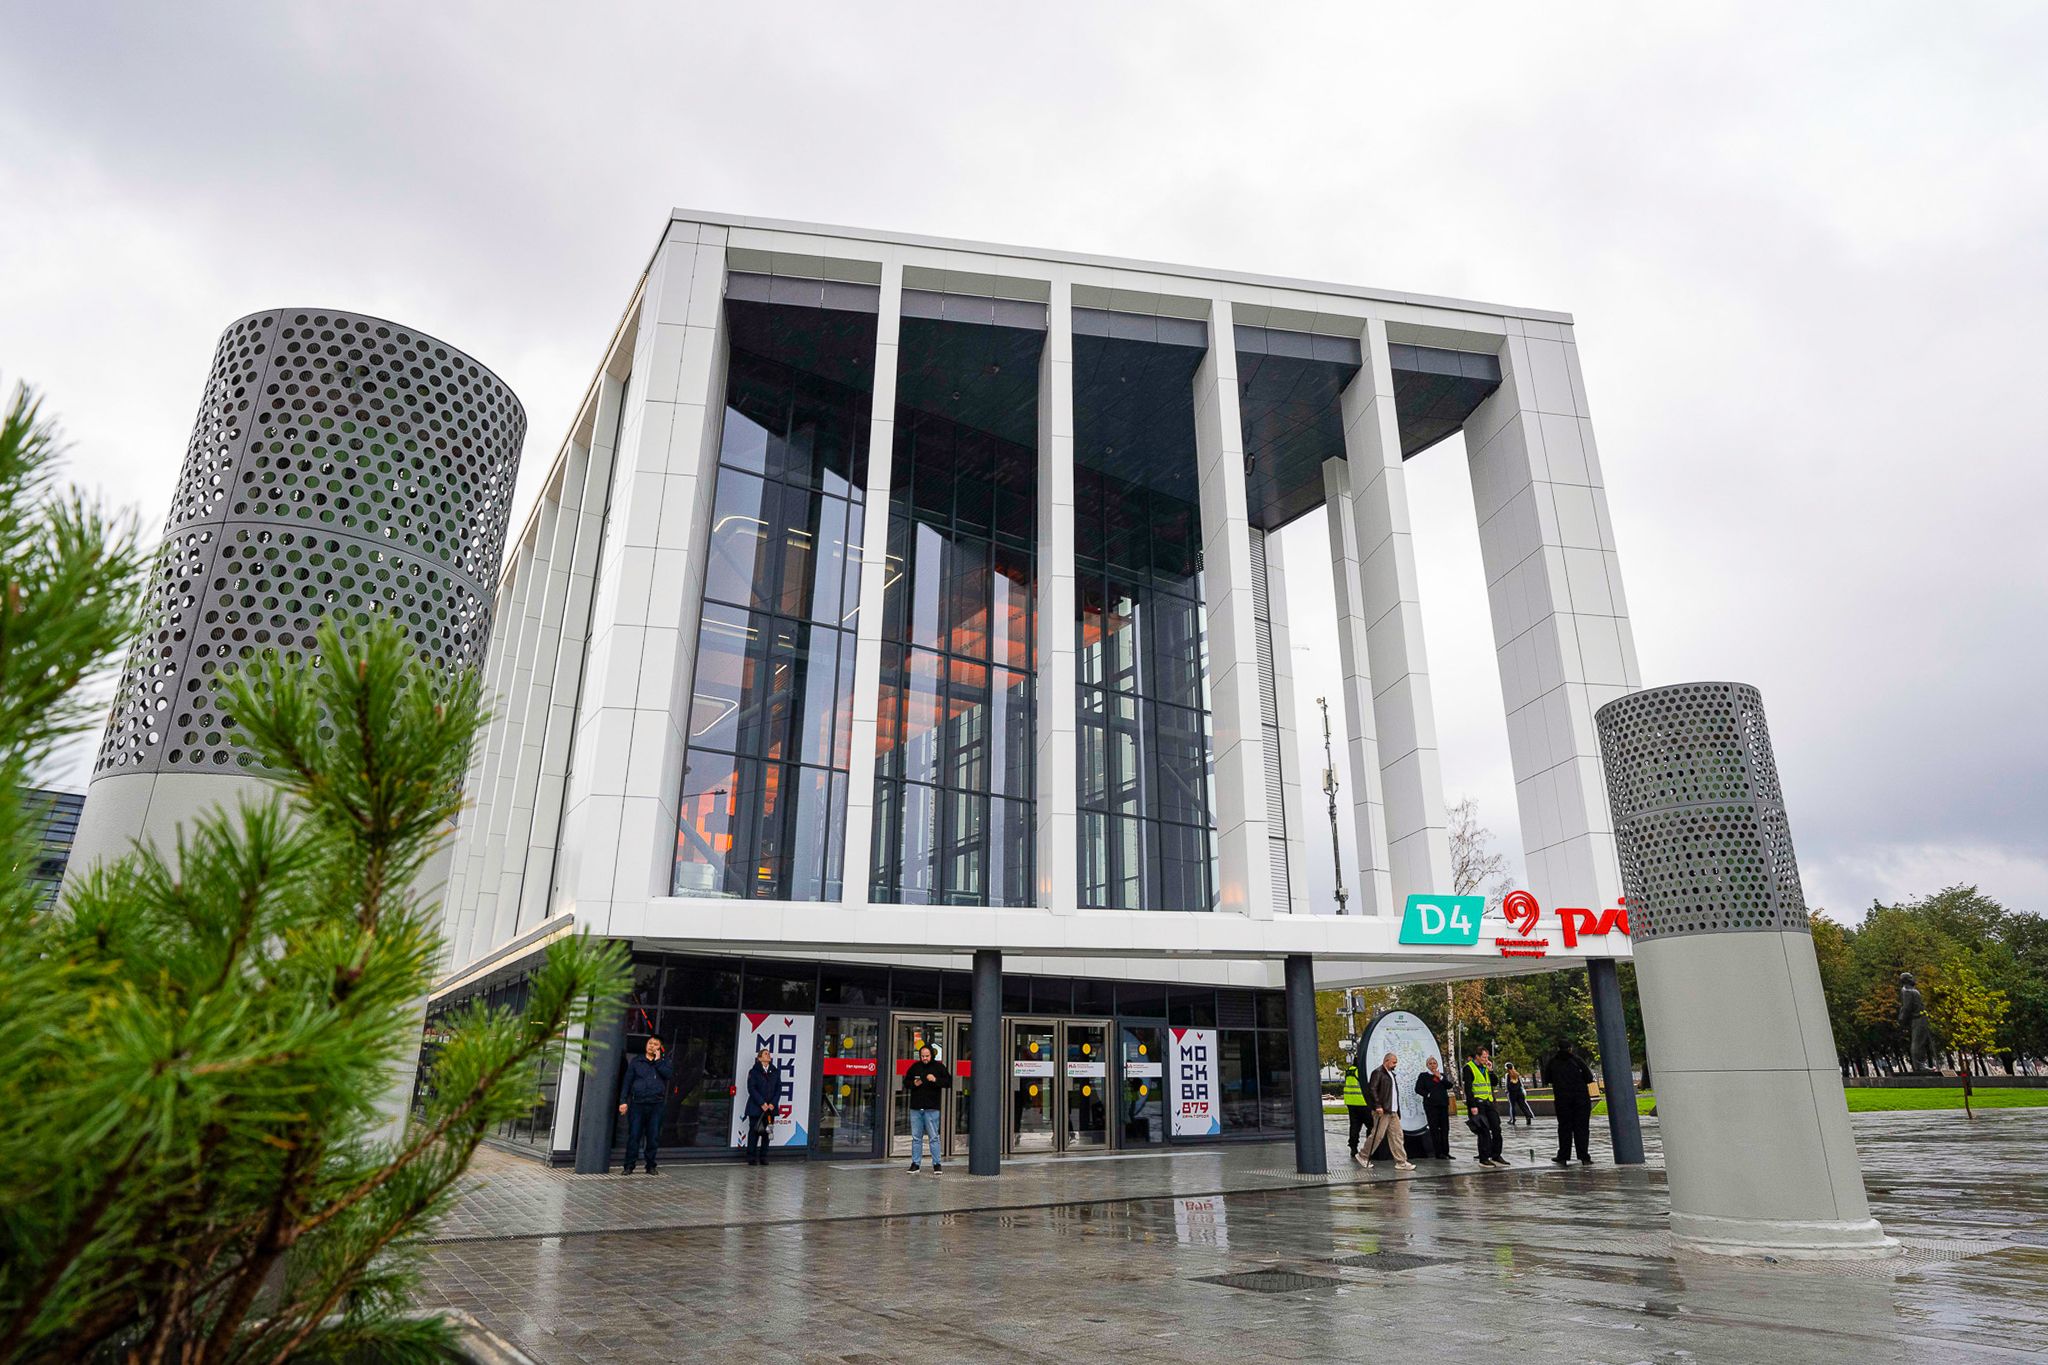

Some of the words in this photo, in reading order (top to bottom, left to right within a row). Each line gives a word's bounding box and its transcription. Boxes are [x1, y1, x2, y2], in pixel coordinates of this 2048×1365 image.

[1416, 904, 1472, 936] D4
[755, 1033, 797, 1054] МО
[1180, 1045, 1207, 1061] МО
[1181, 1064, 1207, 1080] СК
[1181, 1084, 1208, 1100] ВА
[1182, 1102, 1209, 1114] 879
